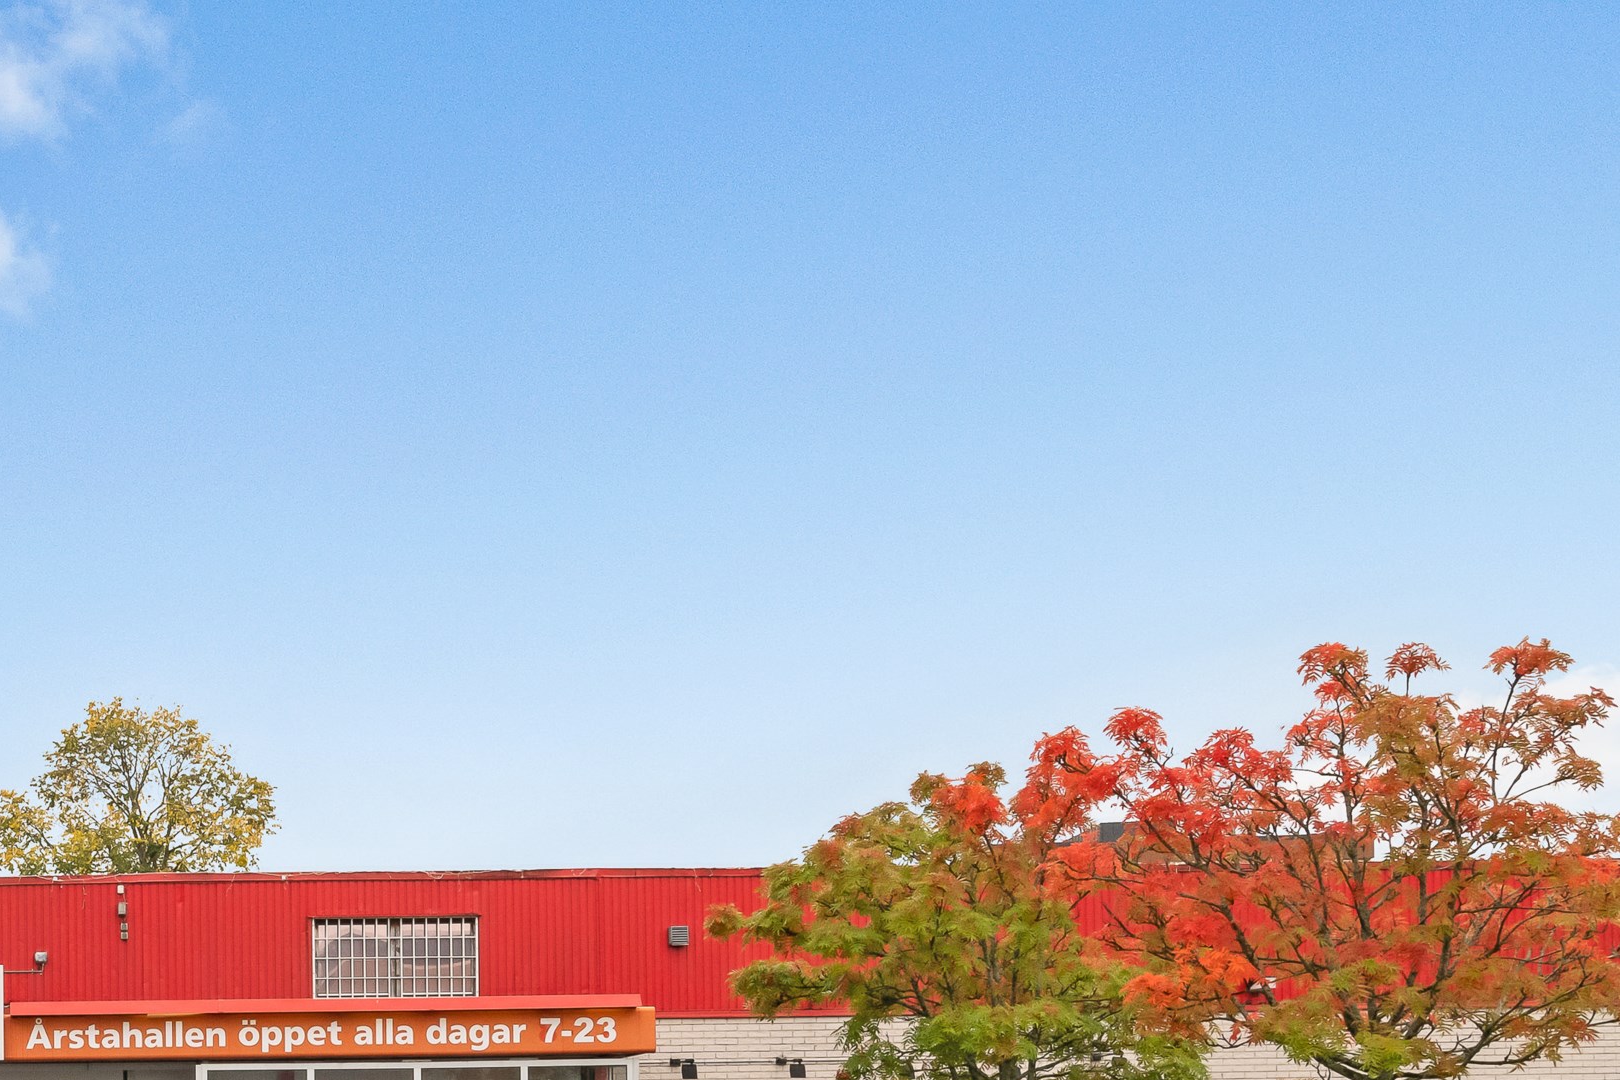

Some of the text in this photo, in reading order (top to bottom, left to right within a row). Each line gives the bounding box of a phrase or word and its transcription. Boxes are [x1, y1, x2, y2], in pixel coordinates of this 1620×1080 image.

[25, 1016, 618, 1053] Årstahallen öppet alla dagar 7-23
